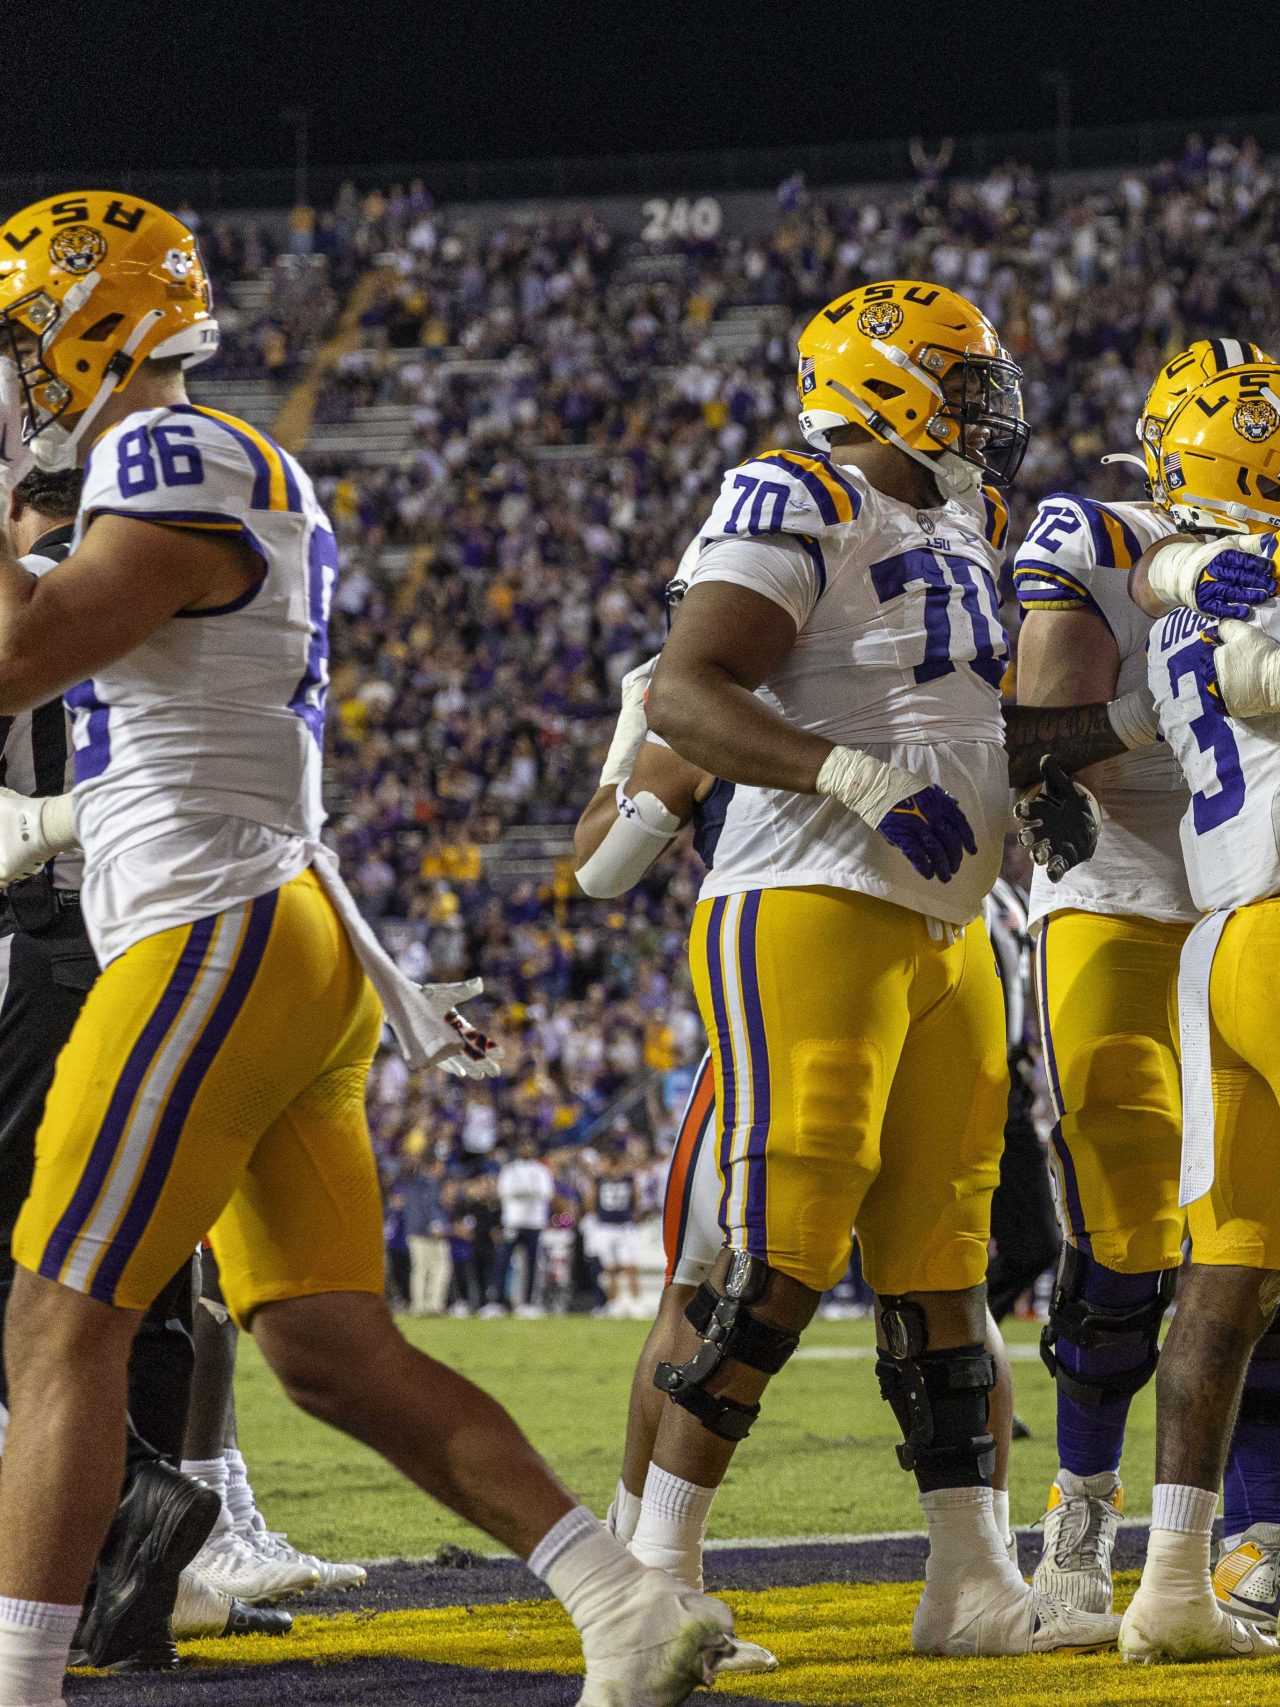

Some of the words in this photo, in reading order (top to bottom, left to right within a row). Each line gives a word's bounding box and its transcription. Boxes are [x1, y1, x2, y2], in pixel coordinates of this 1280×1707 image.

[3, 198, 146, 252] LSU
[641, 197, 721, 240] 240
[823, 284, 941, 325] LSU
[117, 425, 204, 499] 86
[723, 473, 791, 535] 70
[926, 537, 951, 551] LSU
[870, 547, 1010, 690] 70
[1161, 607, 1217, 652] DIG
[1167, 640, 1246, 836] 3
